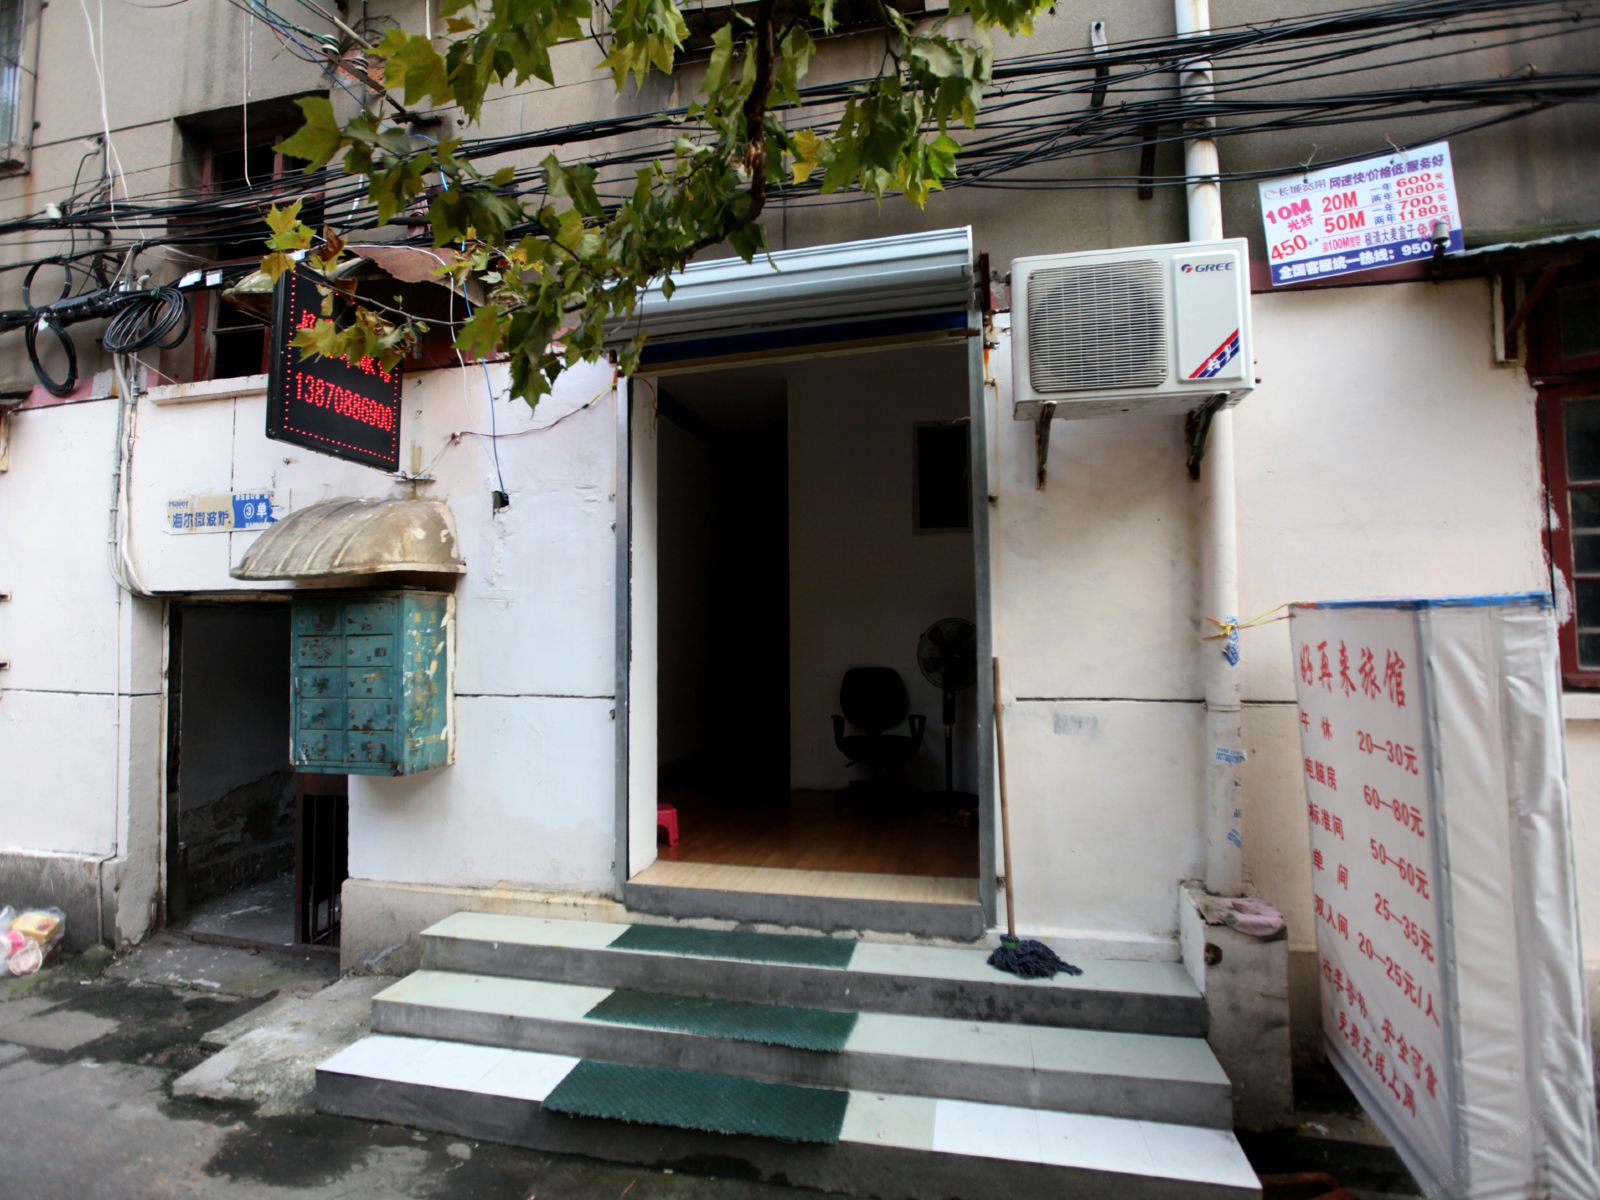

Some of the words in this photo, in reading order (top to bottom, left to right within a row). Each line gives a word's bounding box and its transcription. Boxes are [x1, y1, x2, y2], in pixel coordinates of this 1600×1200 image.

[1266, 198, 1311, 224] 10M
[1322, 191, 1358, 213] 20M
[1287, 214, 1313, 233] 光纤
[1324, 211, 1365, 234] 50M
[1401, 241, 1452, 256] 950
[1195, 262, 1234, 272] GREE
[296, 371, 393, 431] 13870886900
[172, 510, 229, 529] 海尔微波炉
[1299, 639, 1406, 709] 好再来旅馆
[1303, 757, 1337, 791] 电脑房
[1308, 803, 1345, 841] 标准间
[1313, 895, 1349, 941] 双人间
